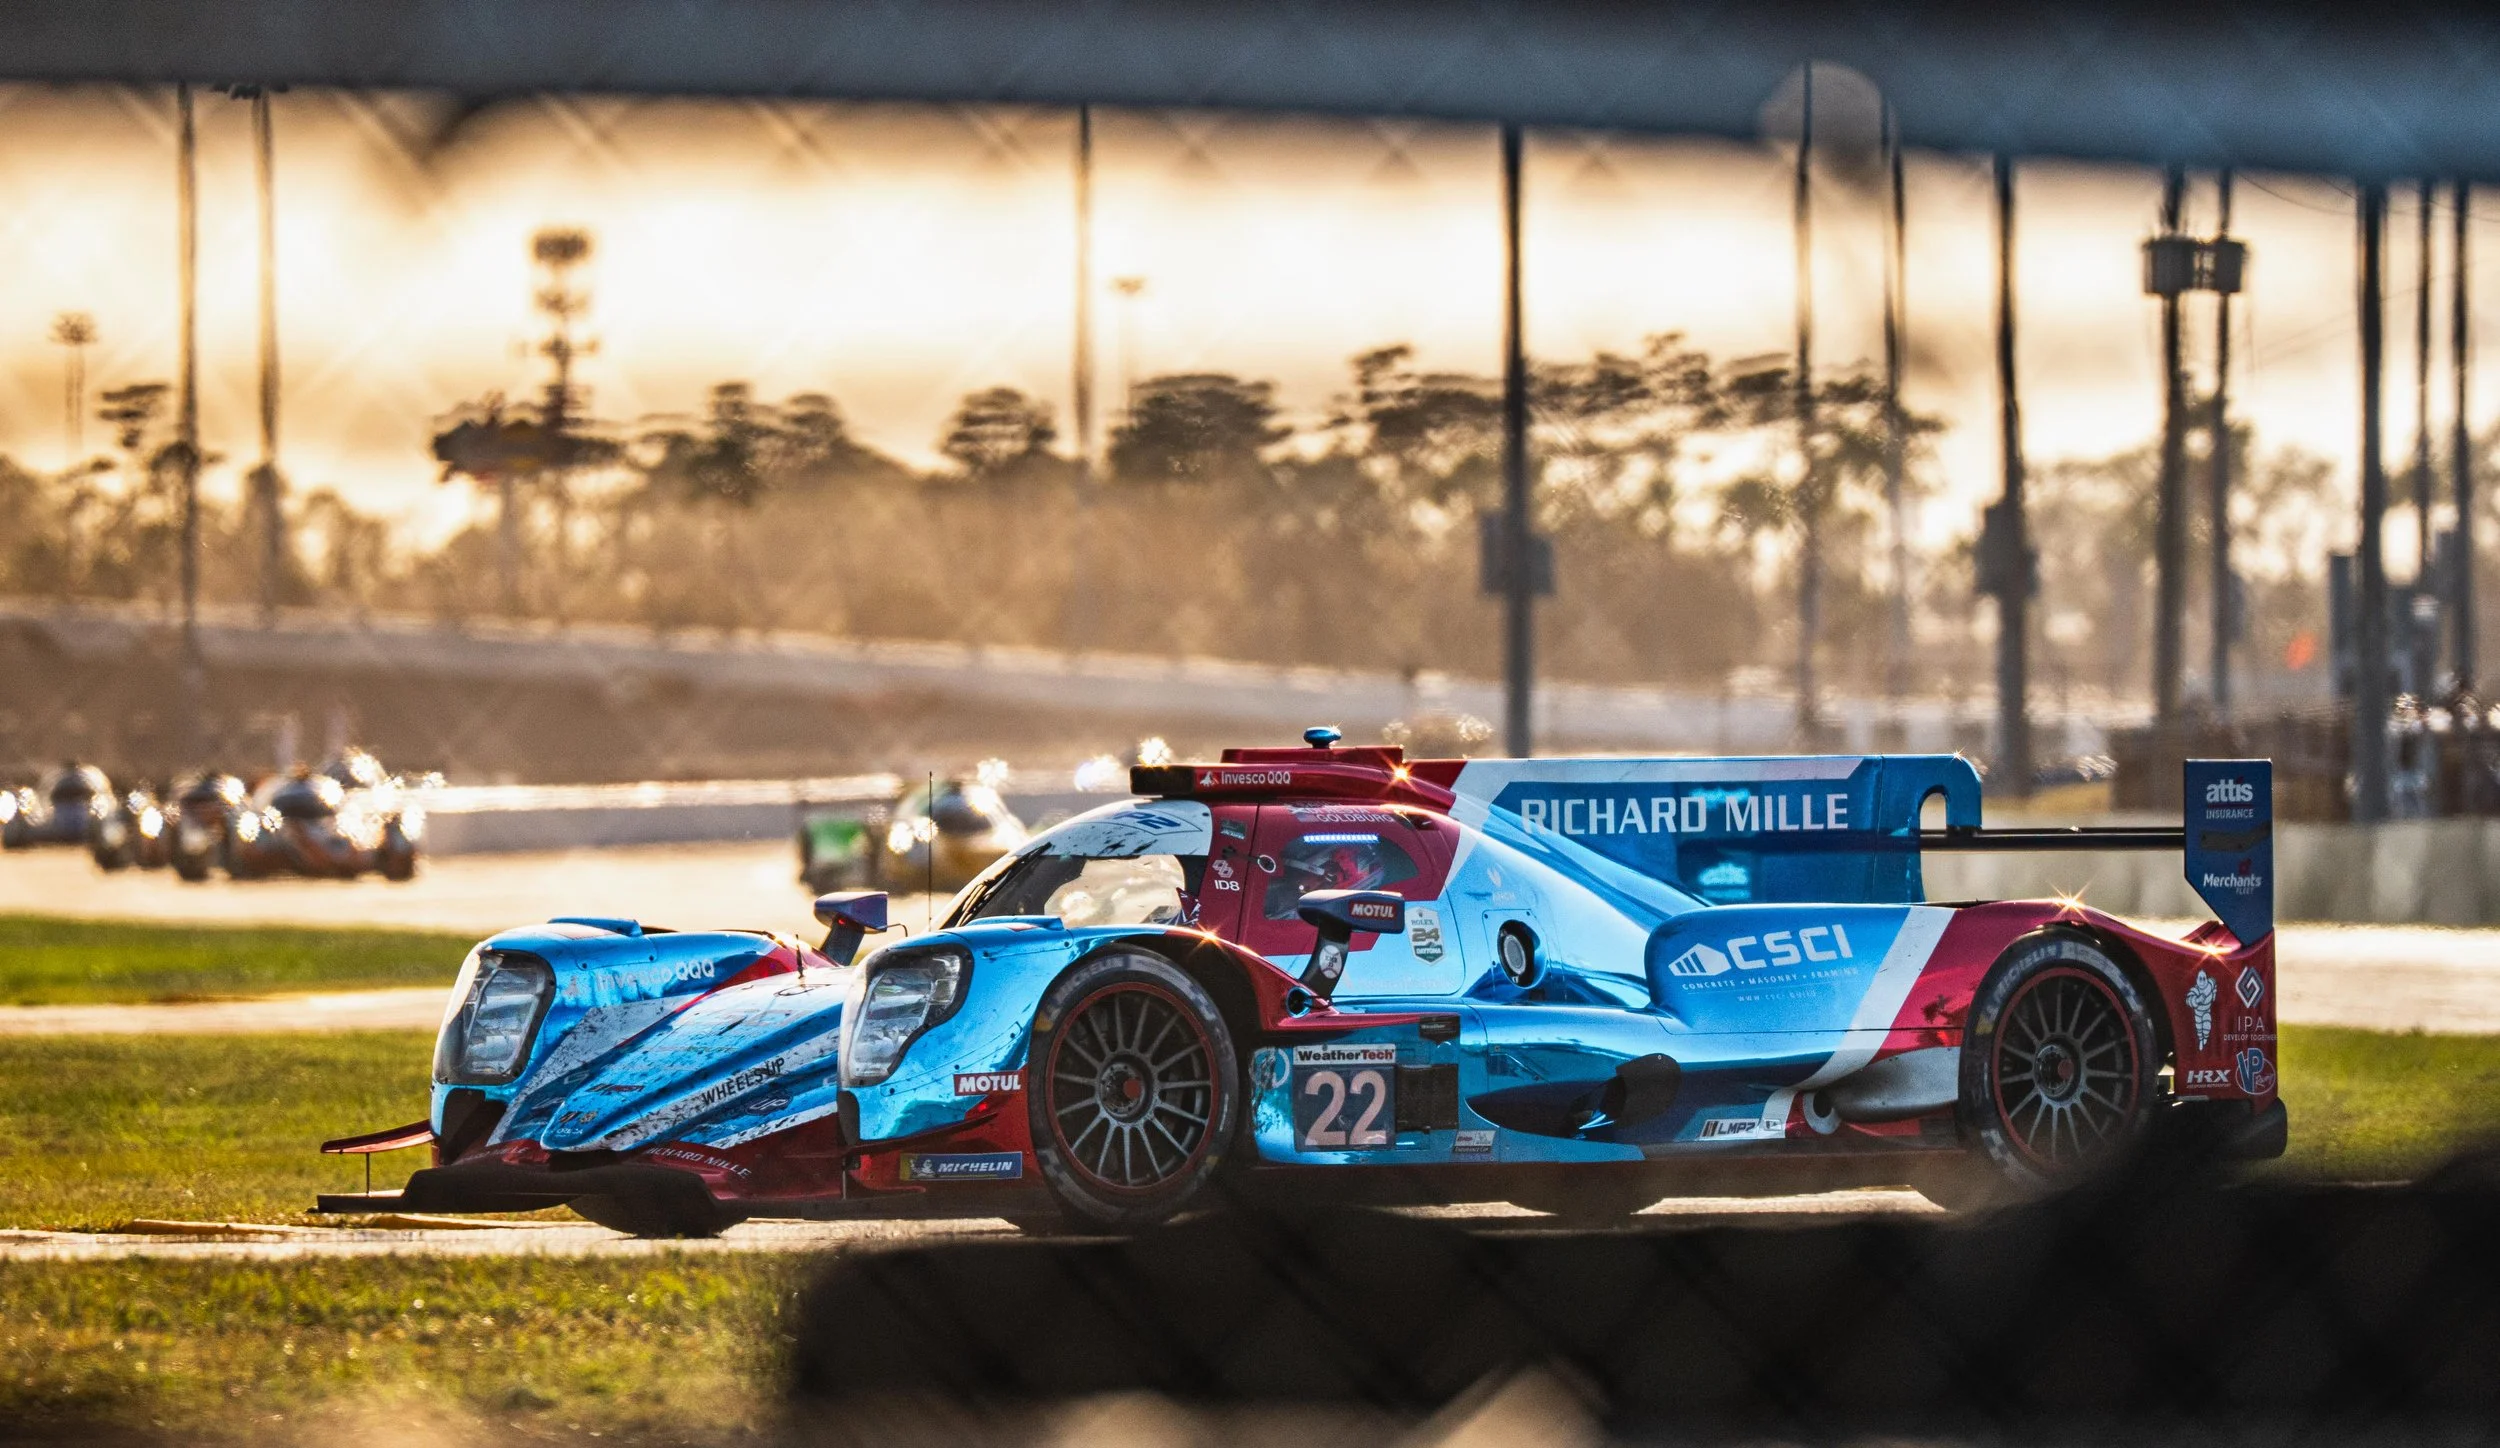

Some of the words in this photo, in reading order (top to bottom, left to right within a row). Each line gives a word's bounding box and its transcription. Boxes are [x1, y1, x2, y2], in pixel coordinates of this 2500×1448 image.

[1221, 771, 1265, 784] Invesco
[1268, 771, 1290, 784] QQQ
[2206, 776, 2253, 802] attis
[1316, 813, 1395, 823] GOLDBURG
[1521, 796, 1707, 835] RICHARD
[1725, 793, 1848, 832] MILLE
[2206, 808, 2254, 819] INSURANCE
[1215, 880, 1241, 891] ID8
[2203, 873, 2262, 888] Merchants
[1352, 903, 1394, 918] MOTUL
[1412, 927, 1440, 942] 24
[1727, 924, 1853, 970] CSCI
[674, 958, 715, 981] QQQ
[1682, 979, 1736, 991] CONCRETE
[1749, 973, 1798, 985] MASONRY
[2237, 1016, 2265, 1031] IPA
[1298, 1049, 1394, 1061] WeatherTech
[958, 1075, 1021, 1092] MOTUL
[2187, 1069, 2231, 1083] HRX
[1305, 1071, 1387, 1146] 22
[1718, 1121, 1756, 1135] LMP2
[704, 1156, 752, 1178] MILLE
[938, 1161, 1013, 1174] MICHELIN
